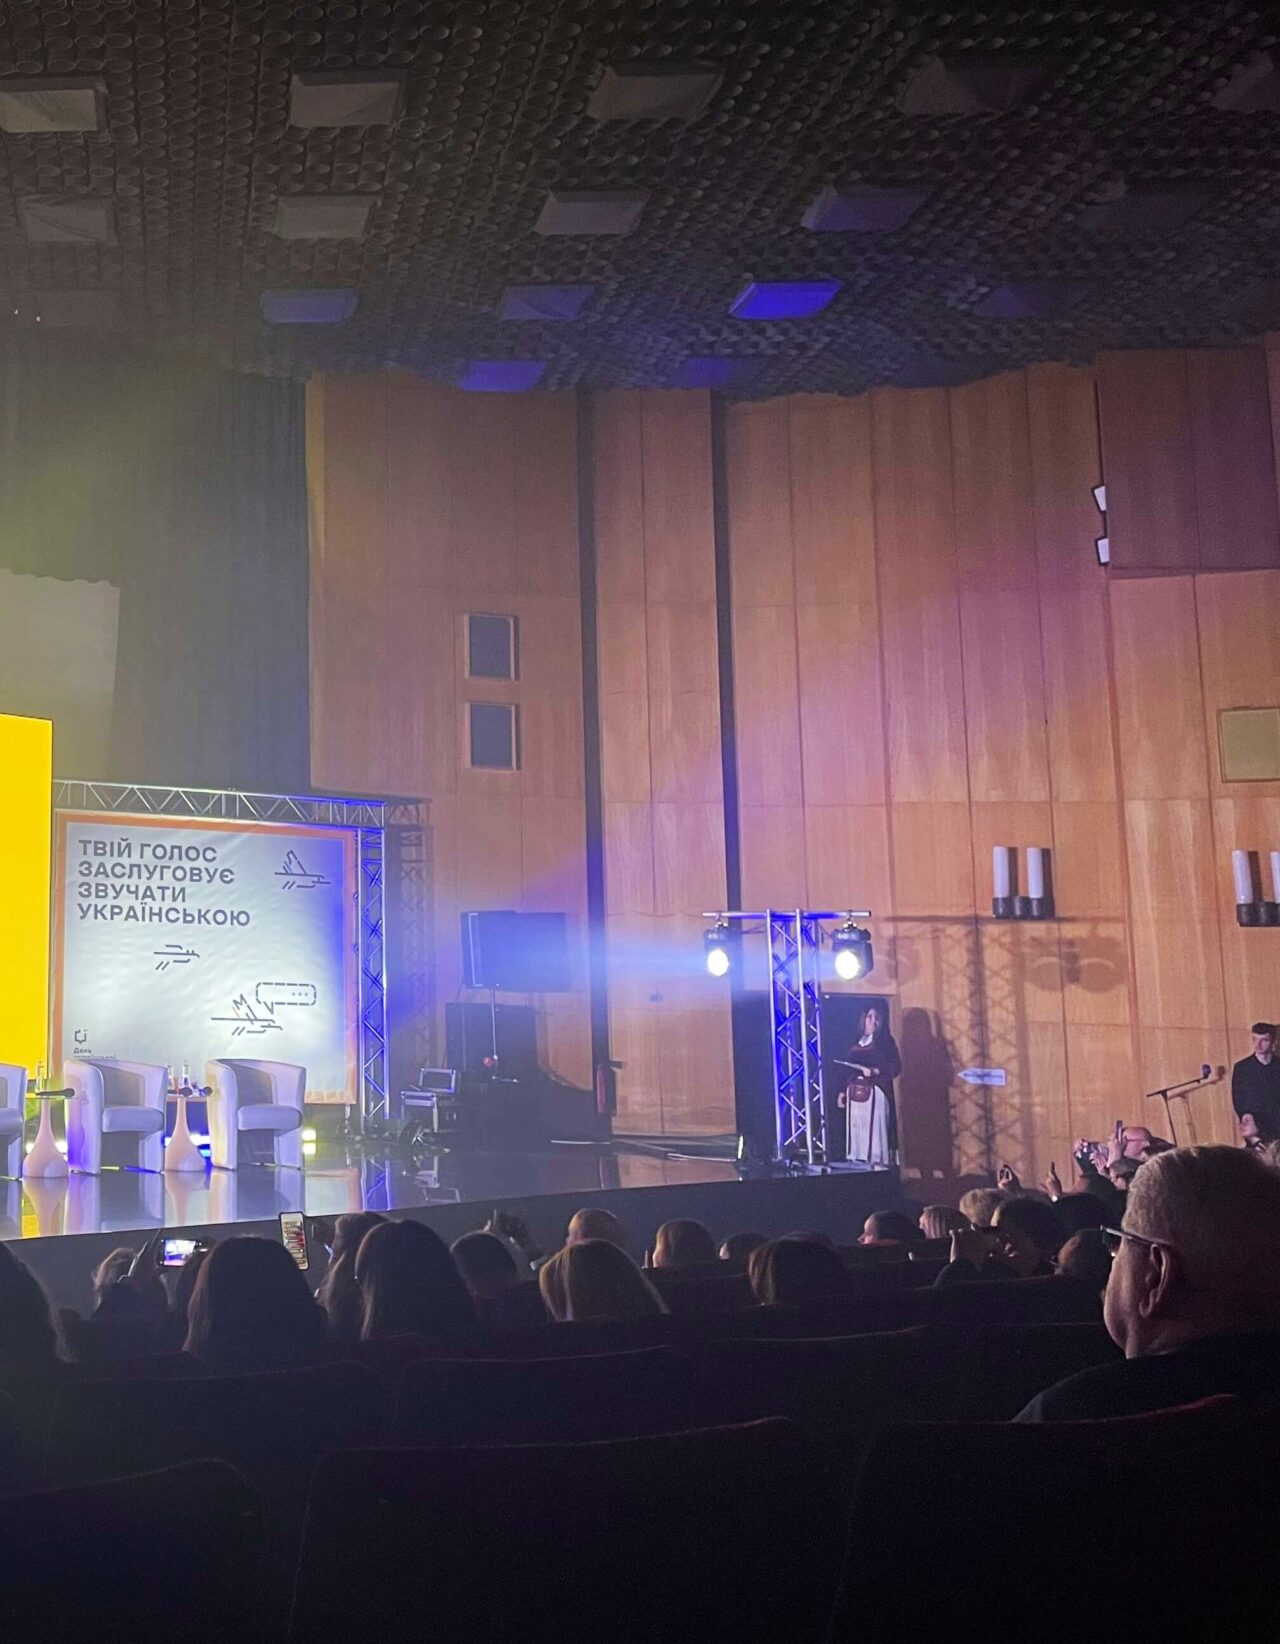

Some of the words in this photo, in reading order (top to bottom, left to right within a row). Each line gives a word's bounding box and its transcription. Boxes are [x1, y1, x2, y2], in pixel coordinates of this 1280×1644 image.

[78, 838, 131, 859] ТВІЙ
[140, 843, 217, 863] ГОЛОС
[78, 861, 235, 884] ЗАСЛУГОВУЄ
[77, 882, 187, 903] ЗВУЧАТИ
[77, 902, 251, 926] УКРАЇНСЬКОЮ
